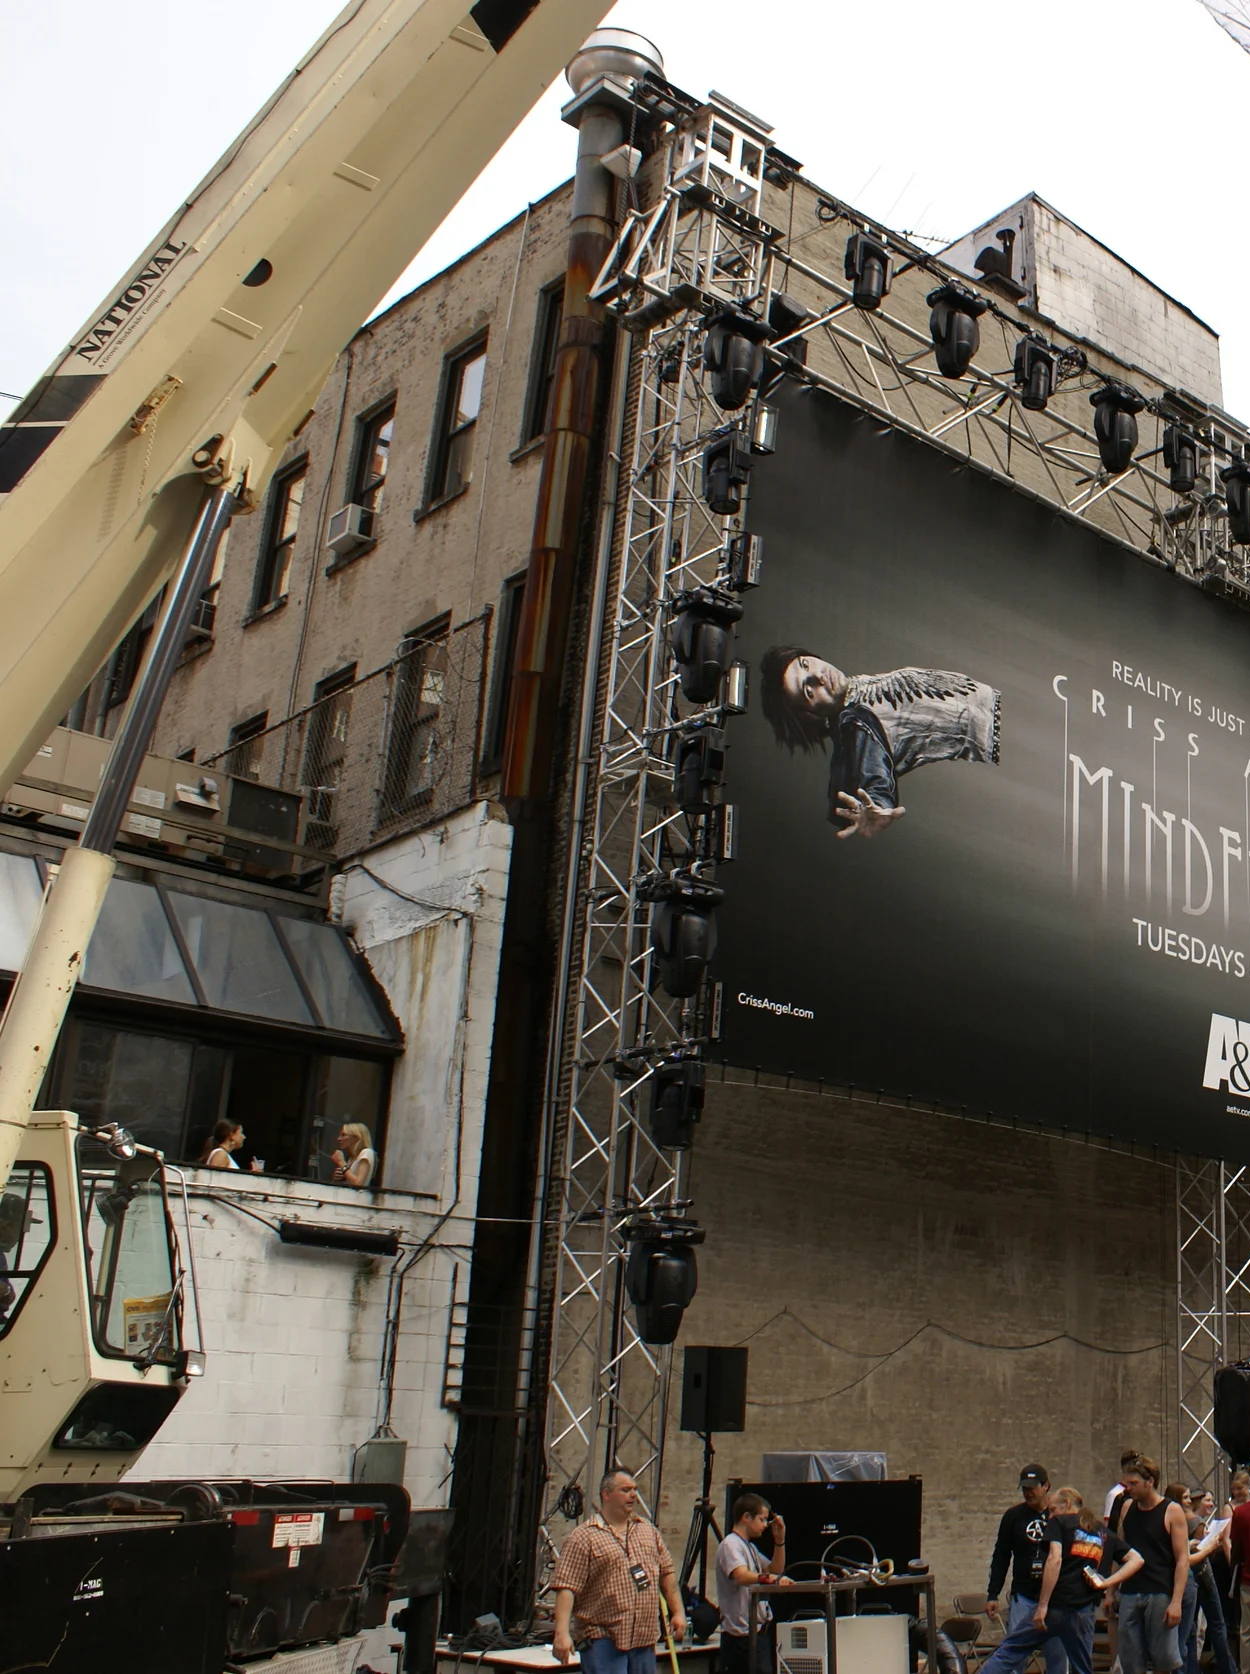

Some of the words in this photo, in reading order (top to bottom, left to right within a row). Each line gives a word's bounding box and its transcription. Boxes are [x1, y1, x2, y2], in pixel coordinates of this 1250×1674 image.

[76, 241, 187, 363] NATIONAL
[142, 288, 167, 315] Company
[1053, 675, 1199, 756] CRISS
[1112, 660, 1182, 706] REALITY
[1188, 695, 1202, 716] IS
[1208, 706, 1245, 735] JUST
[1132, 918, 1245, 978] TUESDAYS
[738, 992, 814, 1019] CrissAngel.com
